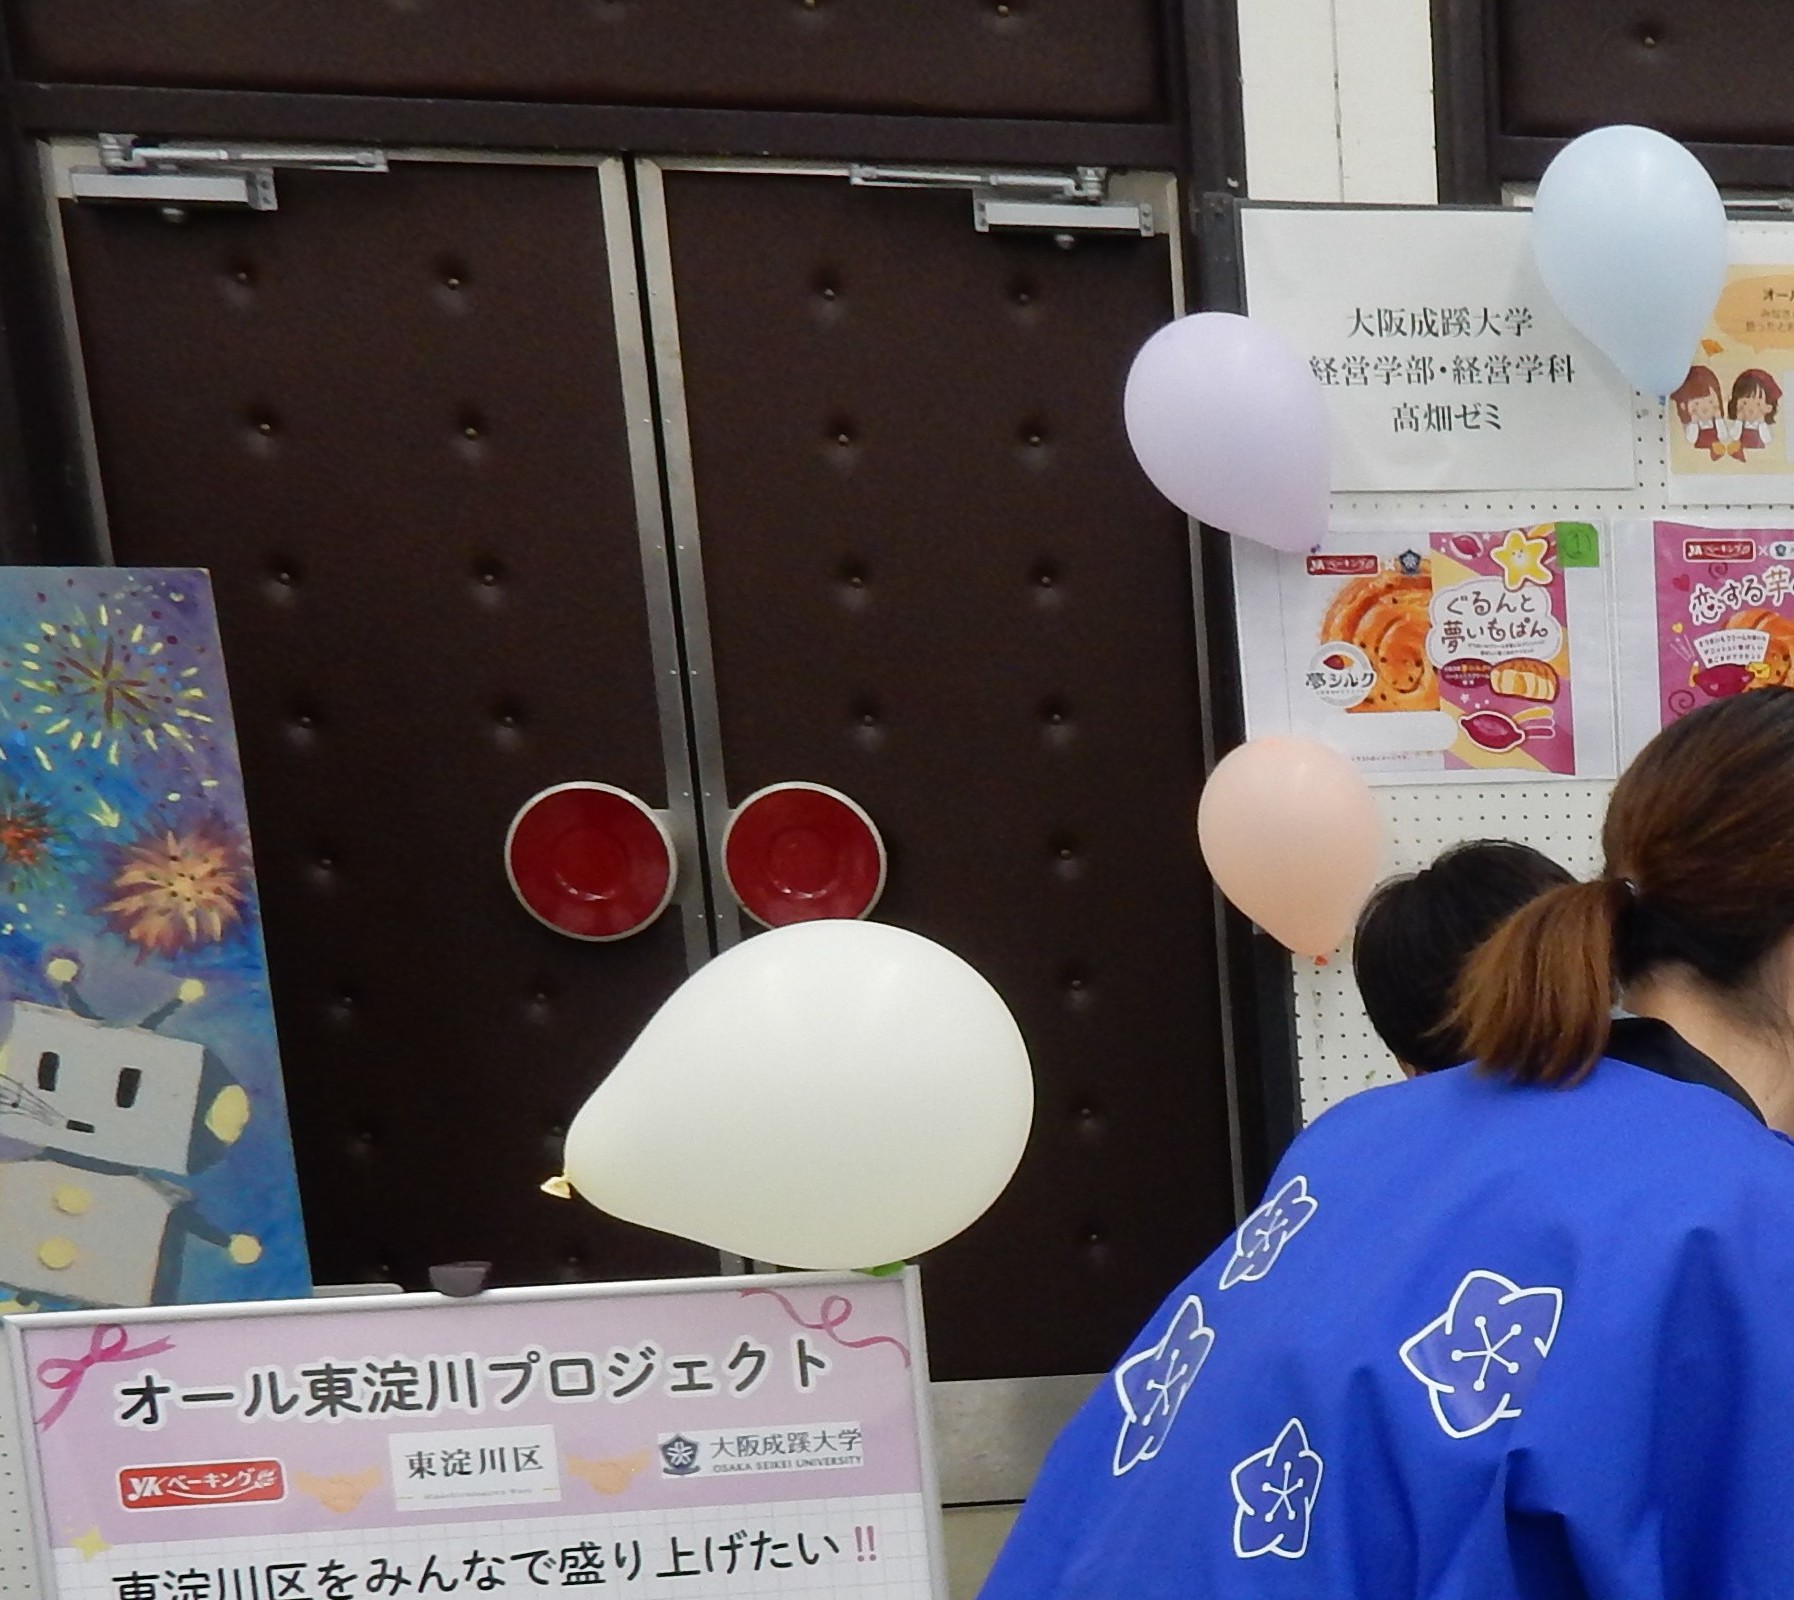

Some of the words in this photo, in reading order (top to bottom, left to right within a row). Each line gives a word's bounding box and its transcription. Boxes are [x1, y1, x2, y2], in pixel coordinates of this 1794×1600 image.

[1347, 305, 1534, 339] 大阪成蹊大学
[1308, 353, 1576, 387] 経営学部・経営学科
[1391, 401, 1503, 433] 高畑ゼミ
[1446, 590, 1536, 616] ぐるんと
[1441, 617, 1549, 655] 夢いもぱん
[118, 1338, 828, 1425] オール東淀川プロジェクト
[710, 1429, 862, 1460] 大阪成蹊大学
[404, 1444, 545, 1480] 東淀川区
